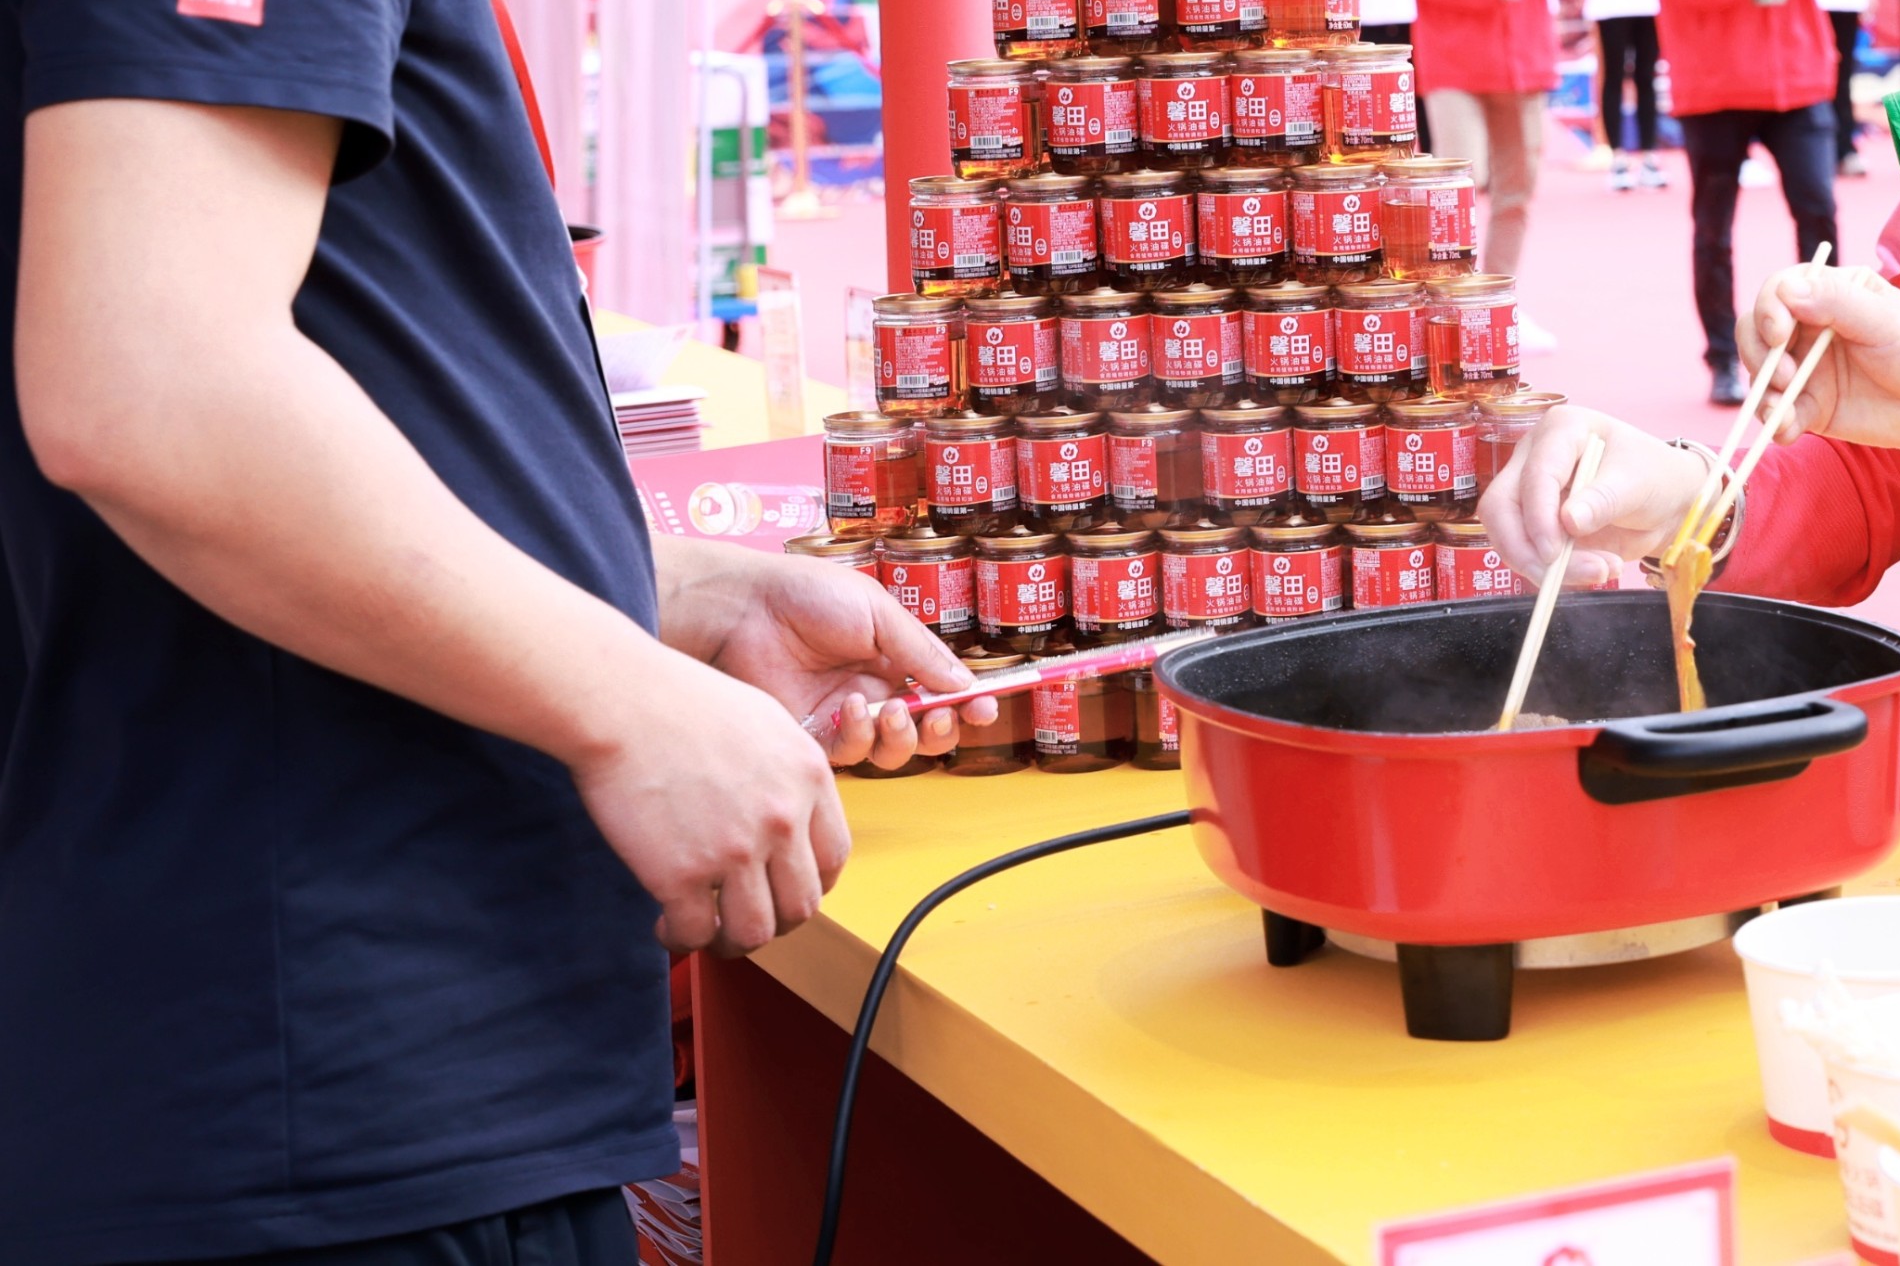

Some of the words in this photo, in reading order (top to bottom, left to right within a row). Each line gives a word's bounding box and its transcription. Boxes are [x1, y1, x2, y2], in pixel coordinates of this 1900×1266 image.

[1167, 98, 1207, 121] 馨田
[1129, 220, 1169, 242] 馨田
[1232, 214, 1272, 236] 馨田
[1332, 212, 1371, 234] 馨田
[1099, 339, 1138, 362] 馨田
[1164, 338, 1203, 359] 馨田
[1270, 334, 1310, 356] 馨田
[1353, 332, 1393, 354] 馨田
[978, 345, 1016, 366] 馨田
[859, 446, 872, 455] F9
[1141, 439, 1154, 448] F9
[1050, 459, 1090, 482] 馨田
[1234, 455, 1275, 477] 馨田
[1305, 452, 1342, 473] 馨田
[1397, 451, 1435, 472] 馨田
[935, 465, 972, 485] 馨田
[1117, 577, 1153, 600] 馨田
[1205, 574, 1242, 597] 馨田
[1265, 575, 1303, 596] 馨田
[1399, 568, 1432, 591] 馨田
[1472, 569, 1512, 591] 馨田
[1017, 580, 1056, 603] 馨田
[1064, 684, 1075, 692] F9
